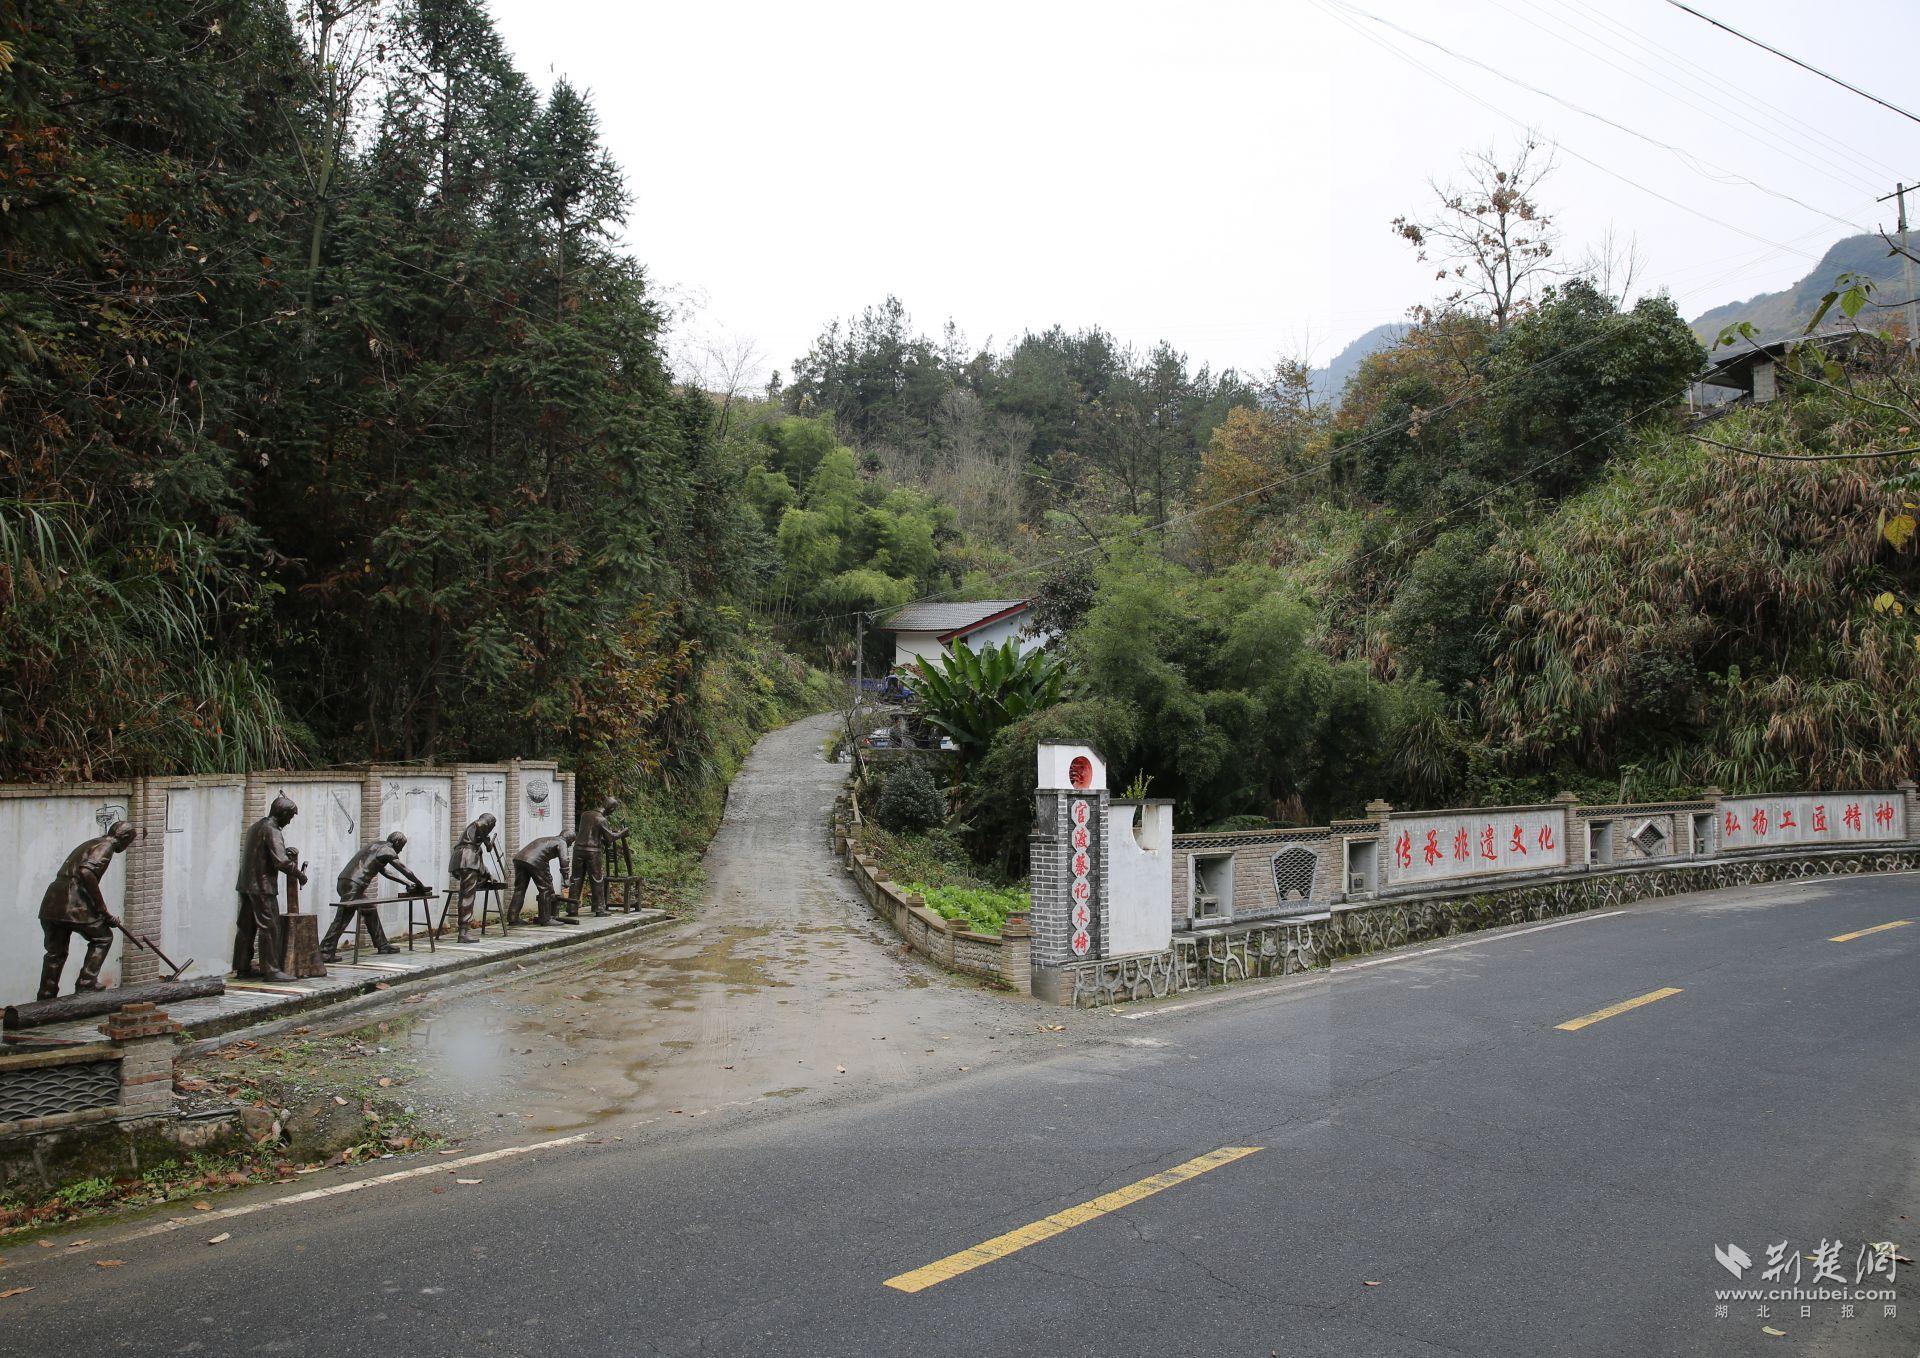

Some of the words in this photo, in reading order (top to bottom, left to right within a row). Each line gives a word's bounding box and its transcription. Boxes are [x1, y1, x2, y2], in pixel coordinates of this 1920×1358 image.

[1725, 801, 1894, 837] 弘扬工匠精神
[1395, 823, 1555, 869] 传承非遗文化
